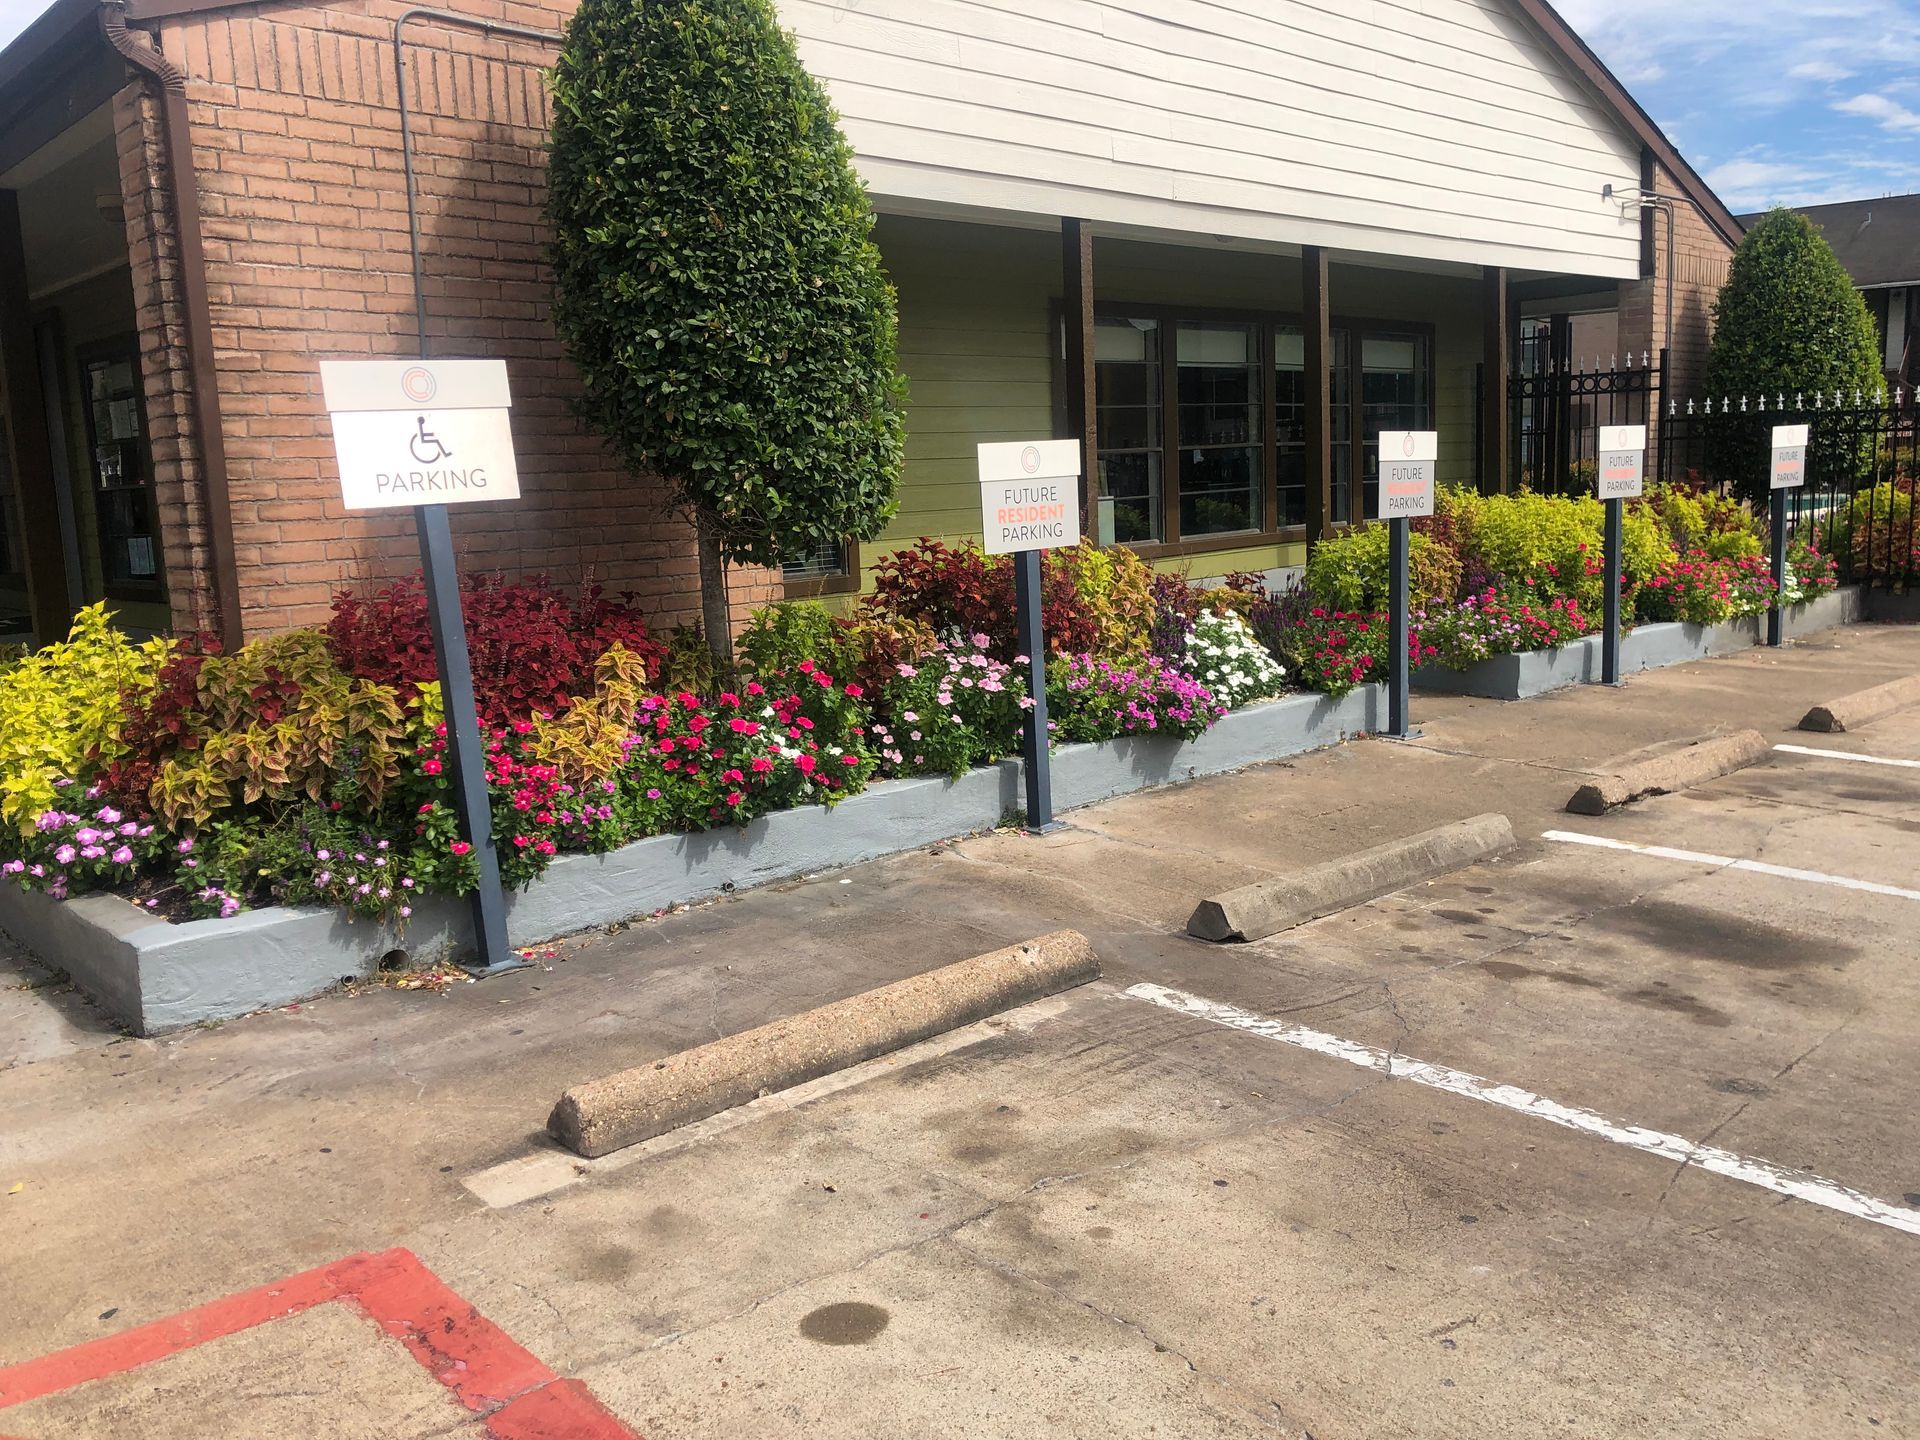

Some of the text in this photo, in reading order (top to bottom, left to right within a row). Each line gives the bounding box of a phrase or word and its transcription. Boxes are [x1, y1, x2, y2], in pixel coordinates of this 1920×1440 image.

[1610, 456, 1634, 467] FUTURE
[376, 468, 487, 493] PARKING
[1392, 467, 1422, 480] FUTURE
[1607, 480, 1635, 492] PARKING
[1004, 486, 1058, 504] FUTURE
[1389, 496, 1424, 510] PARKING
[997, 504, 1066, 524] RESIDENT
[1002, 522, 1063, 542] PARKING
